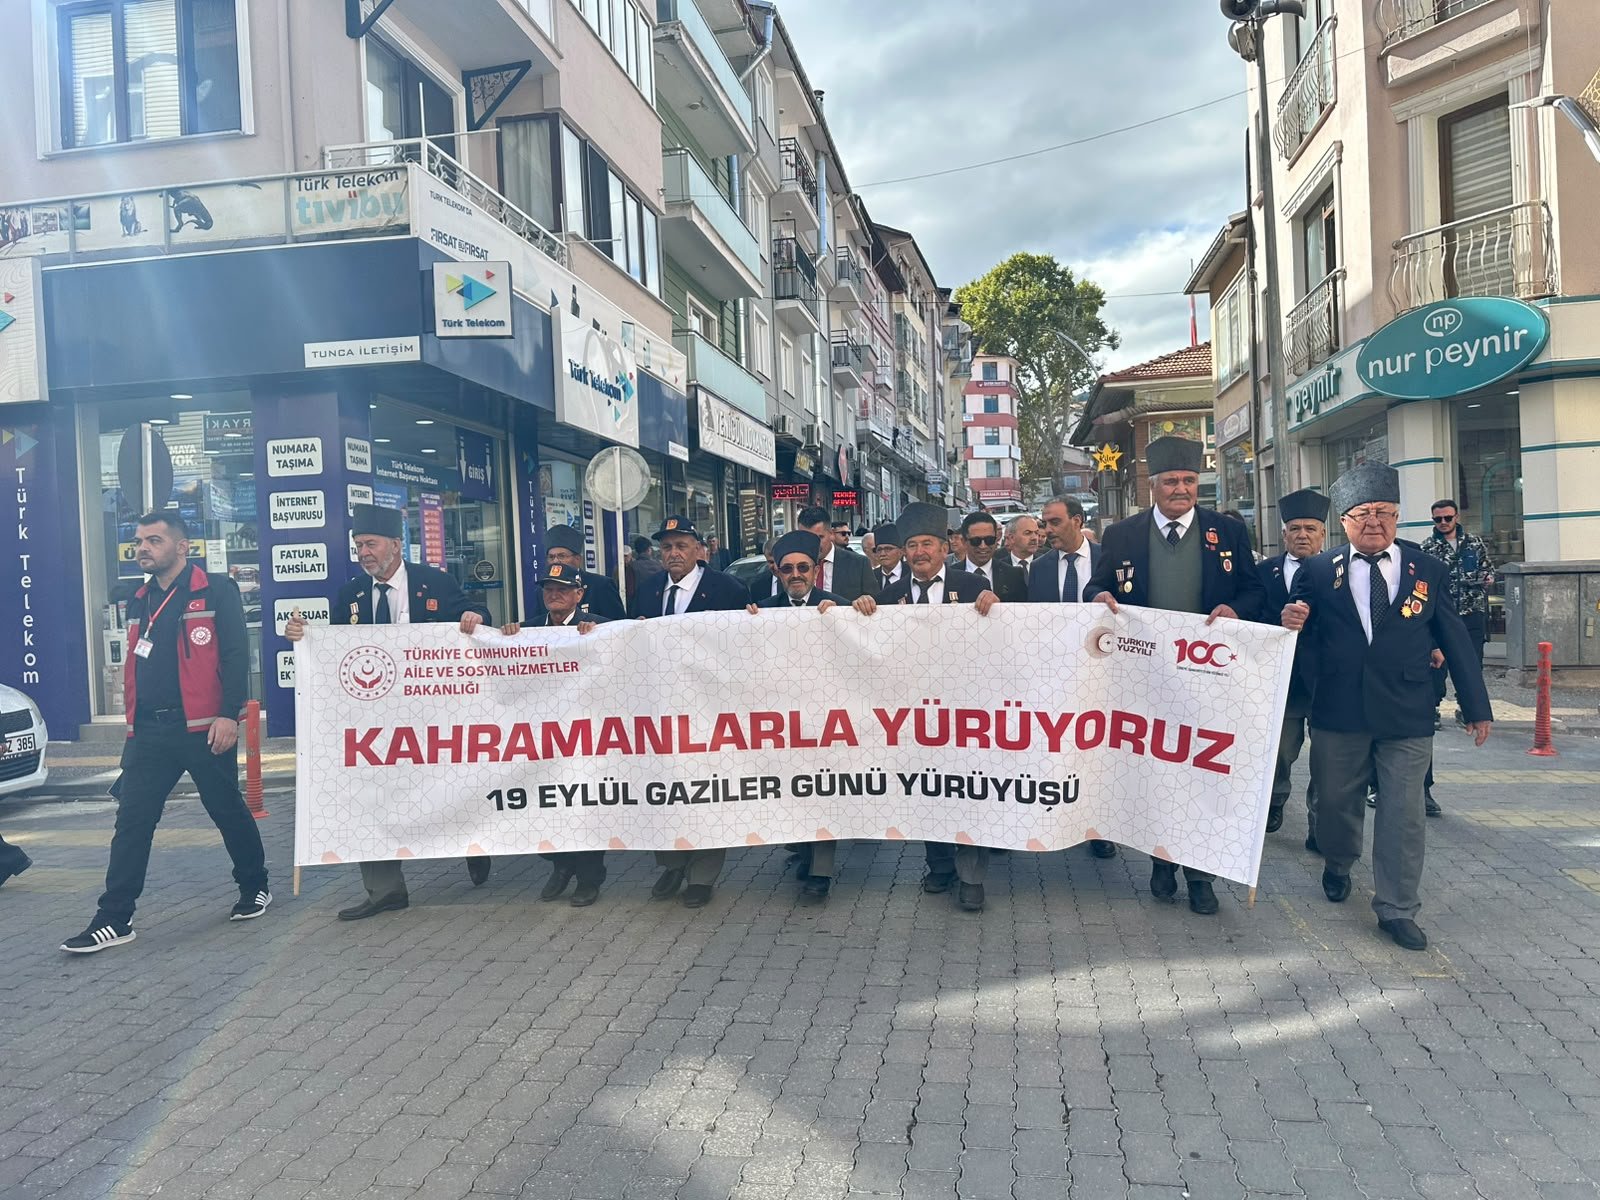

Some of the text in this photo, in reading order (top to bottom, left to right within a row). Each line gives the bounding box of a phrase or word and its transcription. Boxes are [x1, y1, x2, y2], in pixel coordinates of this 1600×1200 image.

[295, 170, 399, 191] Türk Telekom
[430, 228, 457, 250] FIRSAT
[465, 242, 489, 261] FIRSAT
[441, 318, 505, 328] Türk Telekom
[1432, 312, 1455, 330] np
[312, 343, 414, 359] TUNCA İLETİŞİM
[1368, 325, 1528, 379] nur peynir
[568, 358, 622, 402] Türk Telekom
[1294, 363, 1342, 422] peynir
[272, 443, 317, 455] NUMARA
[347, 442, 368, 454] NUMARA
[276, 458, 314, 470] TAŞIMA
[350, 456, 368, 466] TAŞIMA
[468, 465, 485, 484] GİRİŞ
[350, 487, 370, 497] İNTERNET
[276, 495, 318, 507] İNTERNET
[272, 510, 323, 523] BAŞVURUSU
[280, 549, 319, 559] FATURA
[16, 467, 39, 684] Türk Telekom
[275, 561, 325, 574] TAHSİLATI
[277, 610, 328, 621] AKSUAR
[403, 644, 549, 661] TÜRKİYE CUMHURİYETİ
[403, 661, 579, 678] AİLE VE SOSYAL HİZMETLER
[403, 681, 479, 696] BAKANLIĞI
[16, 736, 33, 752] 385
[343, 698, 1235, 775] KAHRAMANLARLA YÜRÜYORUZ
[486, 767, 1080, 812] 19 EYLÜL GAZİLER GÜNÜ YÜRÜYÜŞÜ
